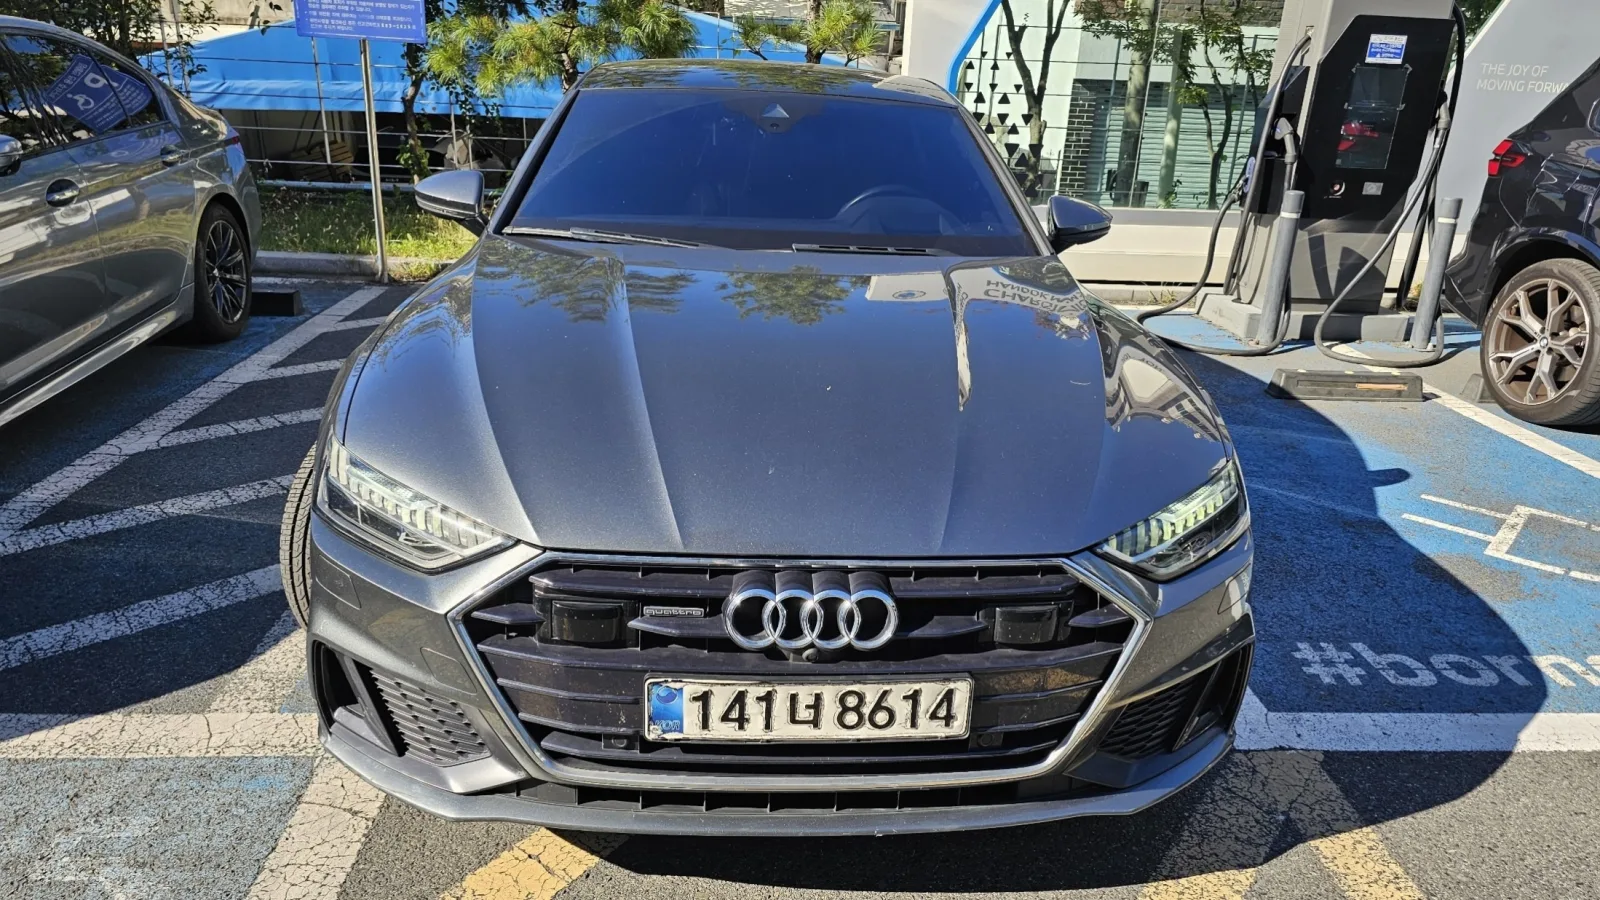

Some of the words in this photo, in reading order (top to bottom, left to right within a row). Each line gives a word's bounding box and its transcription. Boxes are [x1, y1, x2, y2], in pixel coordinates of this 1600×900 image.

[1480, 62, 1507, 75] THE
[1506, 64, 1531, 77] JOY
[1531, 65, 1549, 77] OF
[1476, 78, 1525, 92] MOVING
[645, 607, 702, 617] quattro
[1291, 641, 1600, 687] #born
